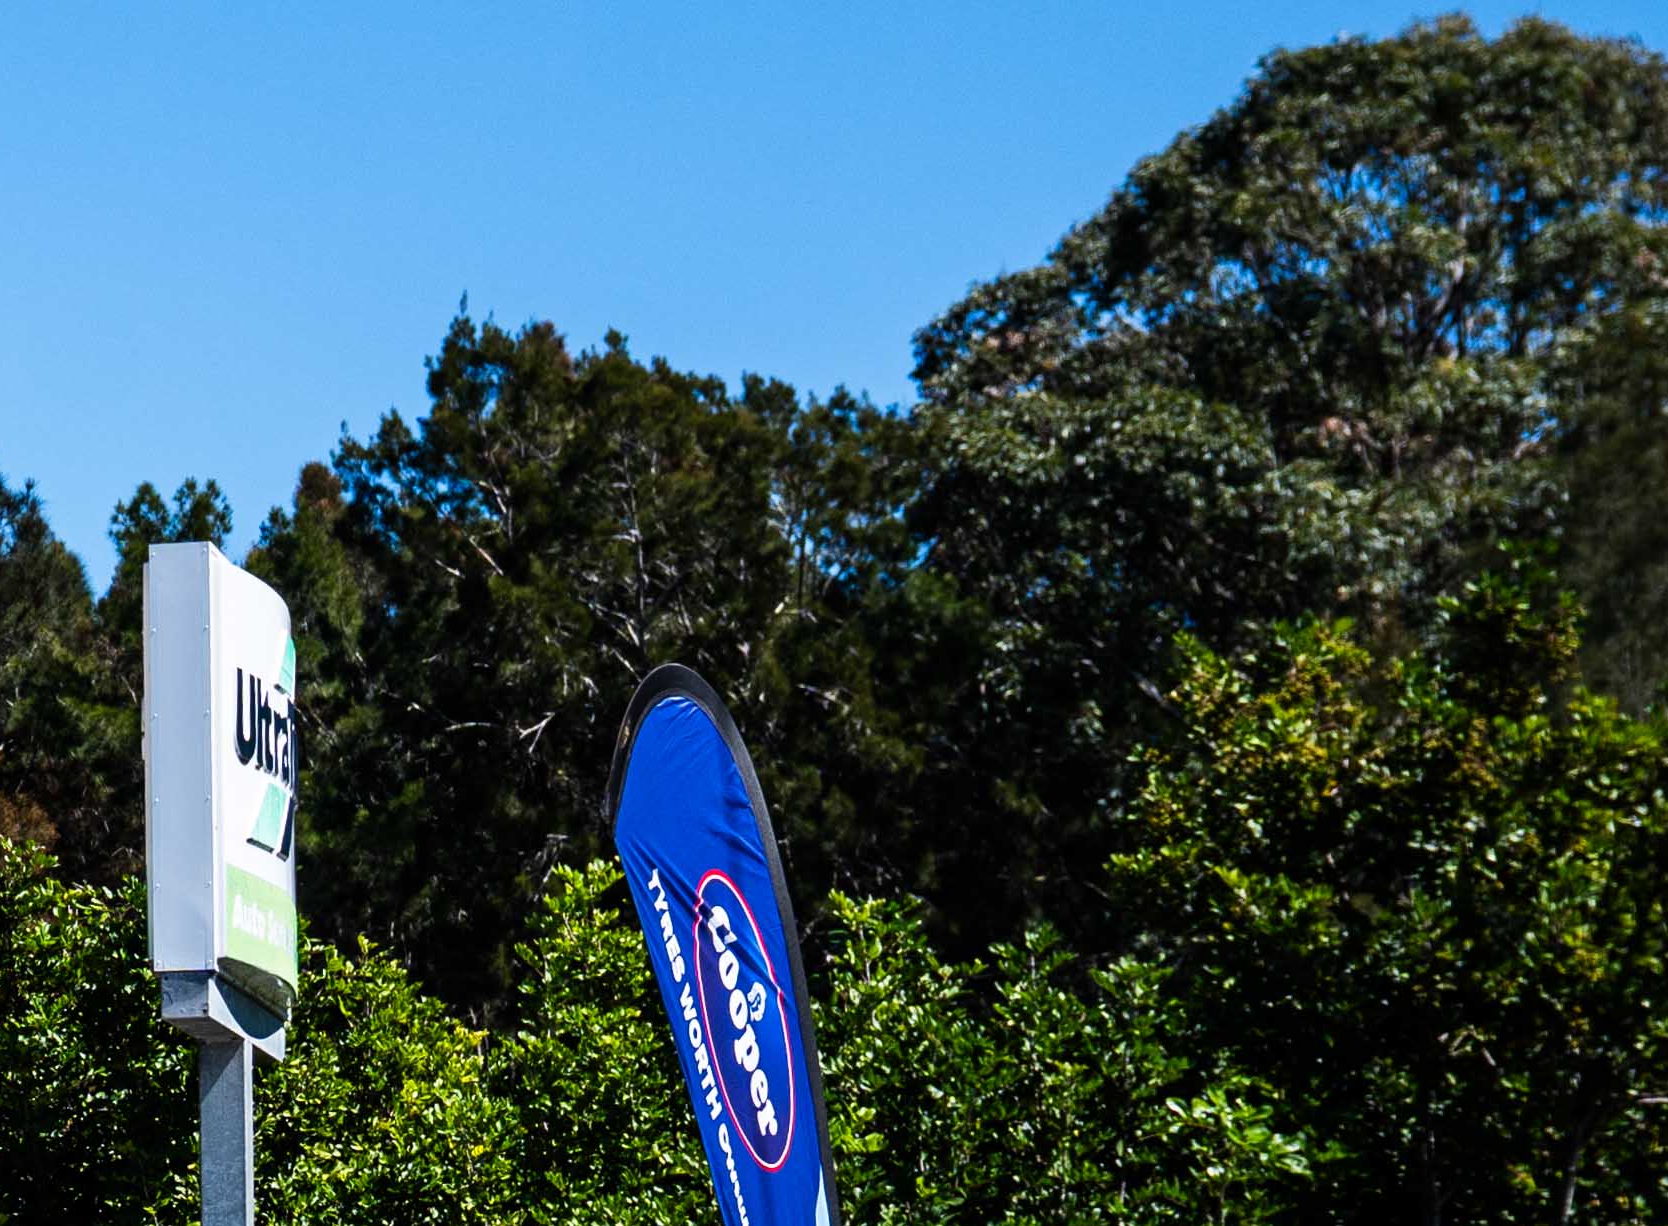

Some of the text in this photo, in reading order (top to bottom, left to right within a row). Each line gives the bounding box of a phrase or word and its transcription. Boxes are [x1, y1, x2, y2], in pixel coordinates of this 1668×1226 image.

[647, 868, 685, 983] TYRES
[679, 983, 722, 1121] WORTH
[708, 904, 778, 1138] Cooper
